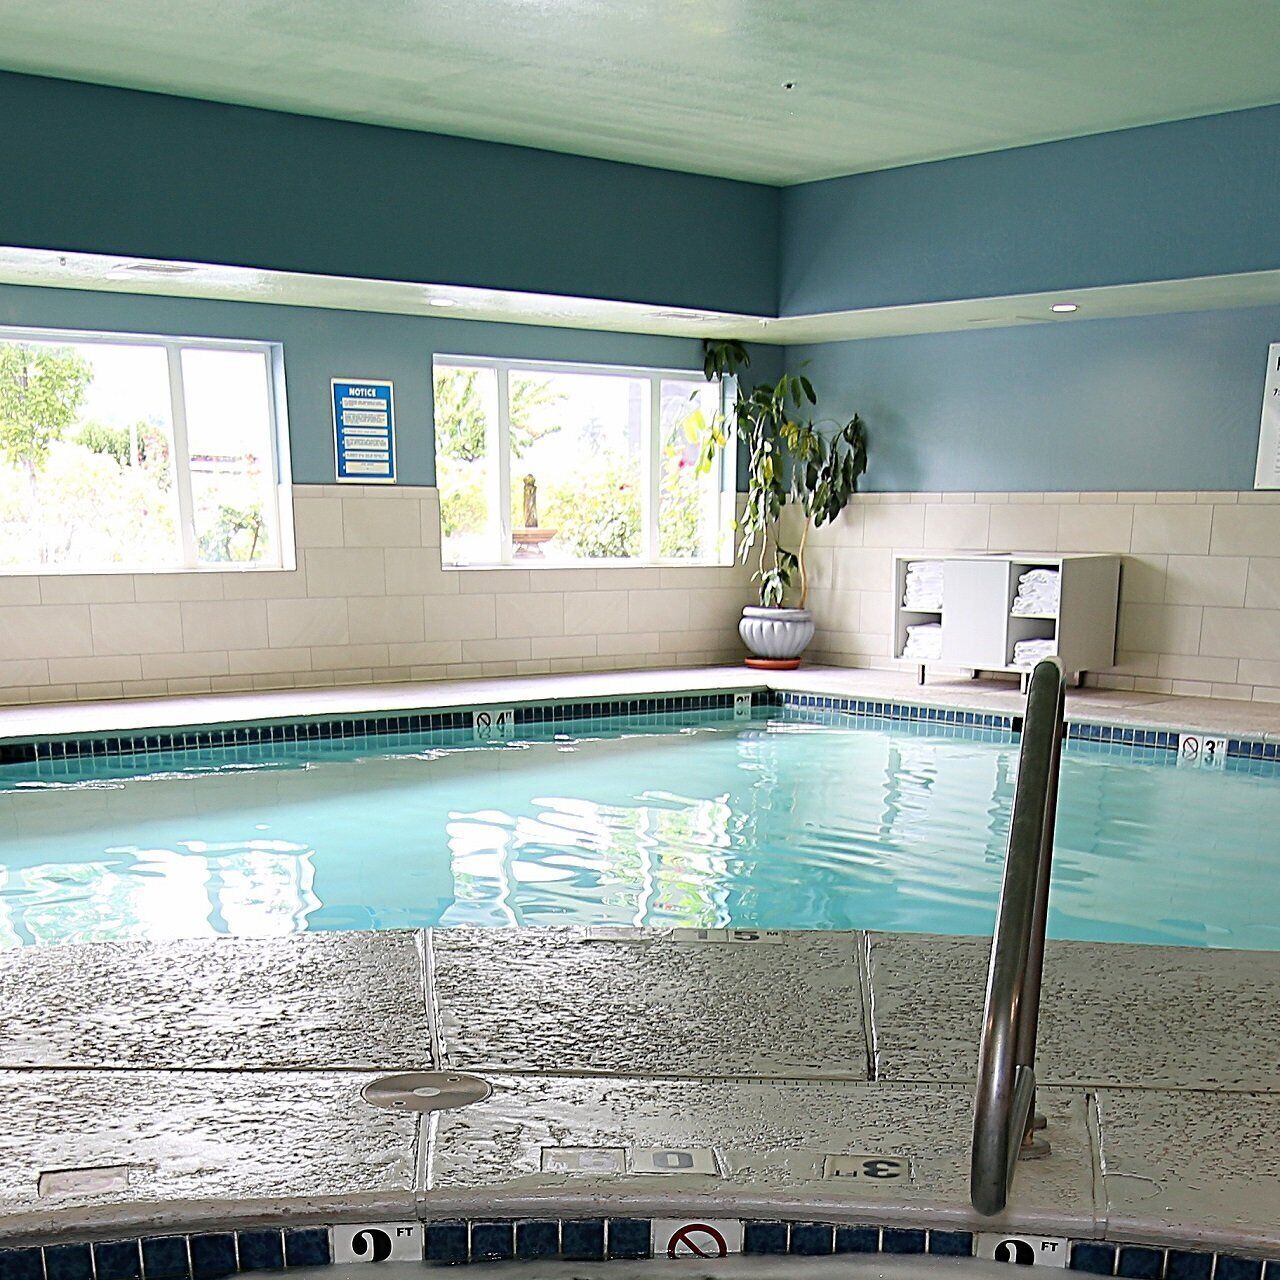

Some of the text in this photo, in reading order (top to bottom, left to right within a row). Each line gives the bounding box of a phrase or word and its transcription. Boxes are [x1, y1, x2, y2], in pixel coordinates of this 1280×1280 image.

[349, 388, 376, 397] NOTICE
[396, 1227, 413, 1237] FT
[1041, 1242, 1059, 1251] FT
